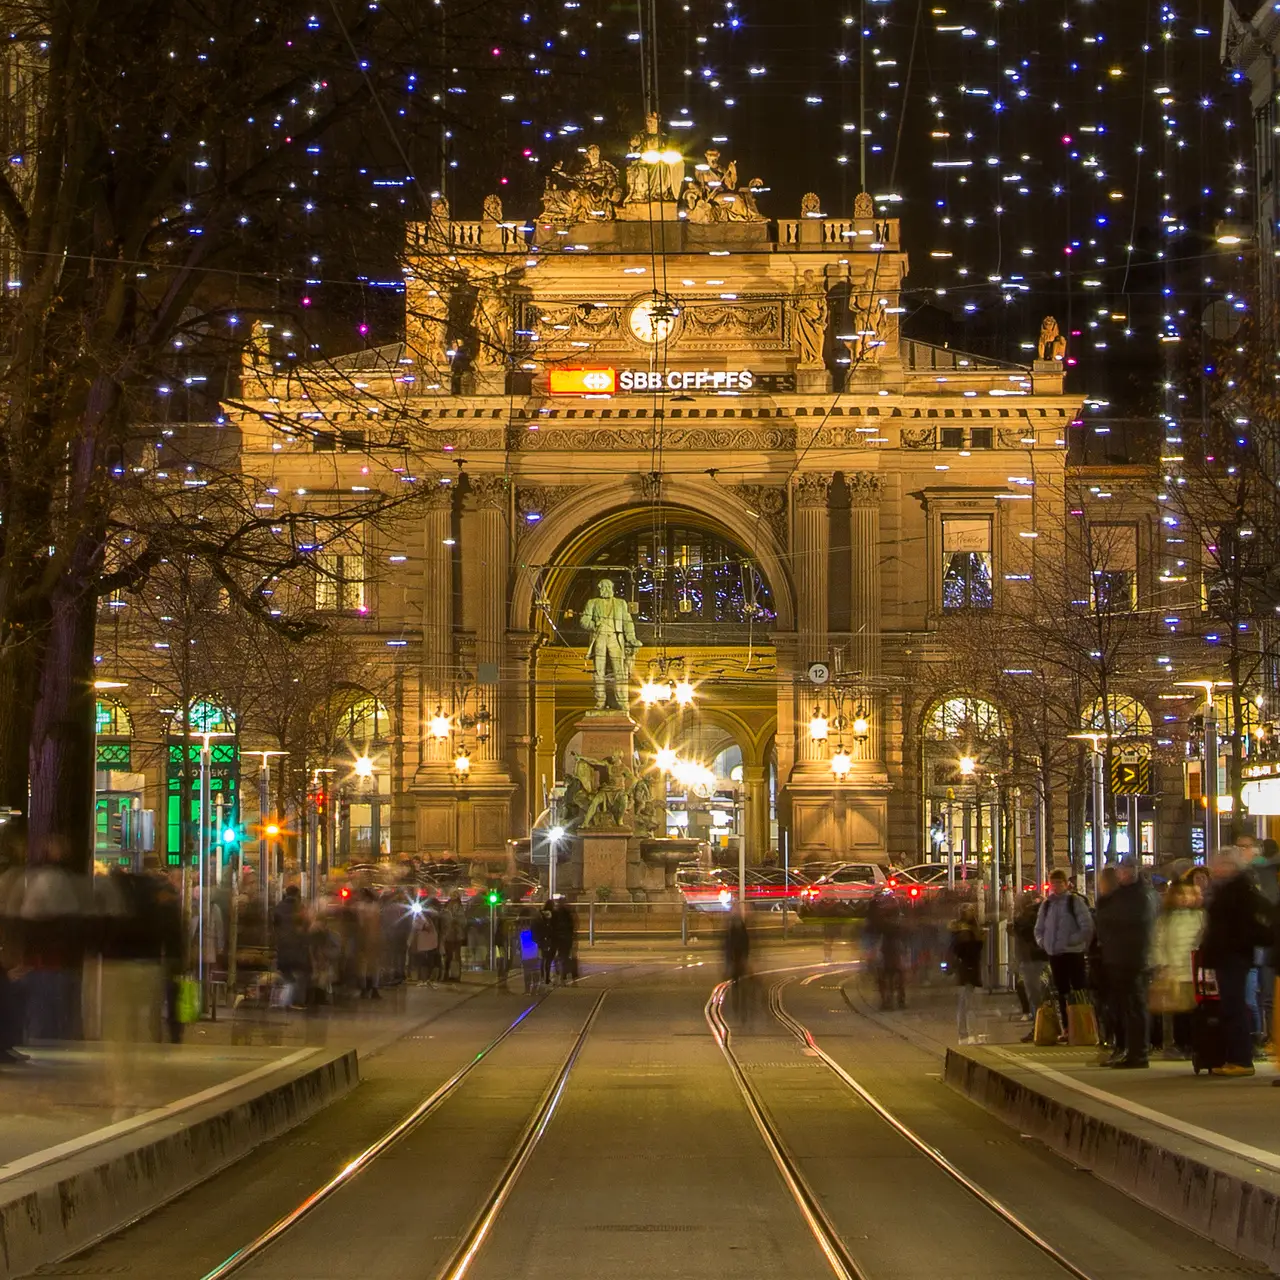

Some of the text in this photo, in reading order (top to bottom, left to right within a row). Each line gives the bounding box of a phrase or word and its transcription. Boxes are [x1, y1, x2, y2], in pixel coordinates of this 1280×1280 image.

[619, 371, 753, 390] SBB CFF FFS
[813, 668, 825, 678] 12
